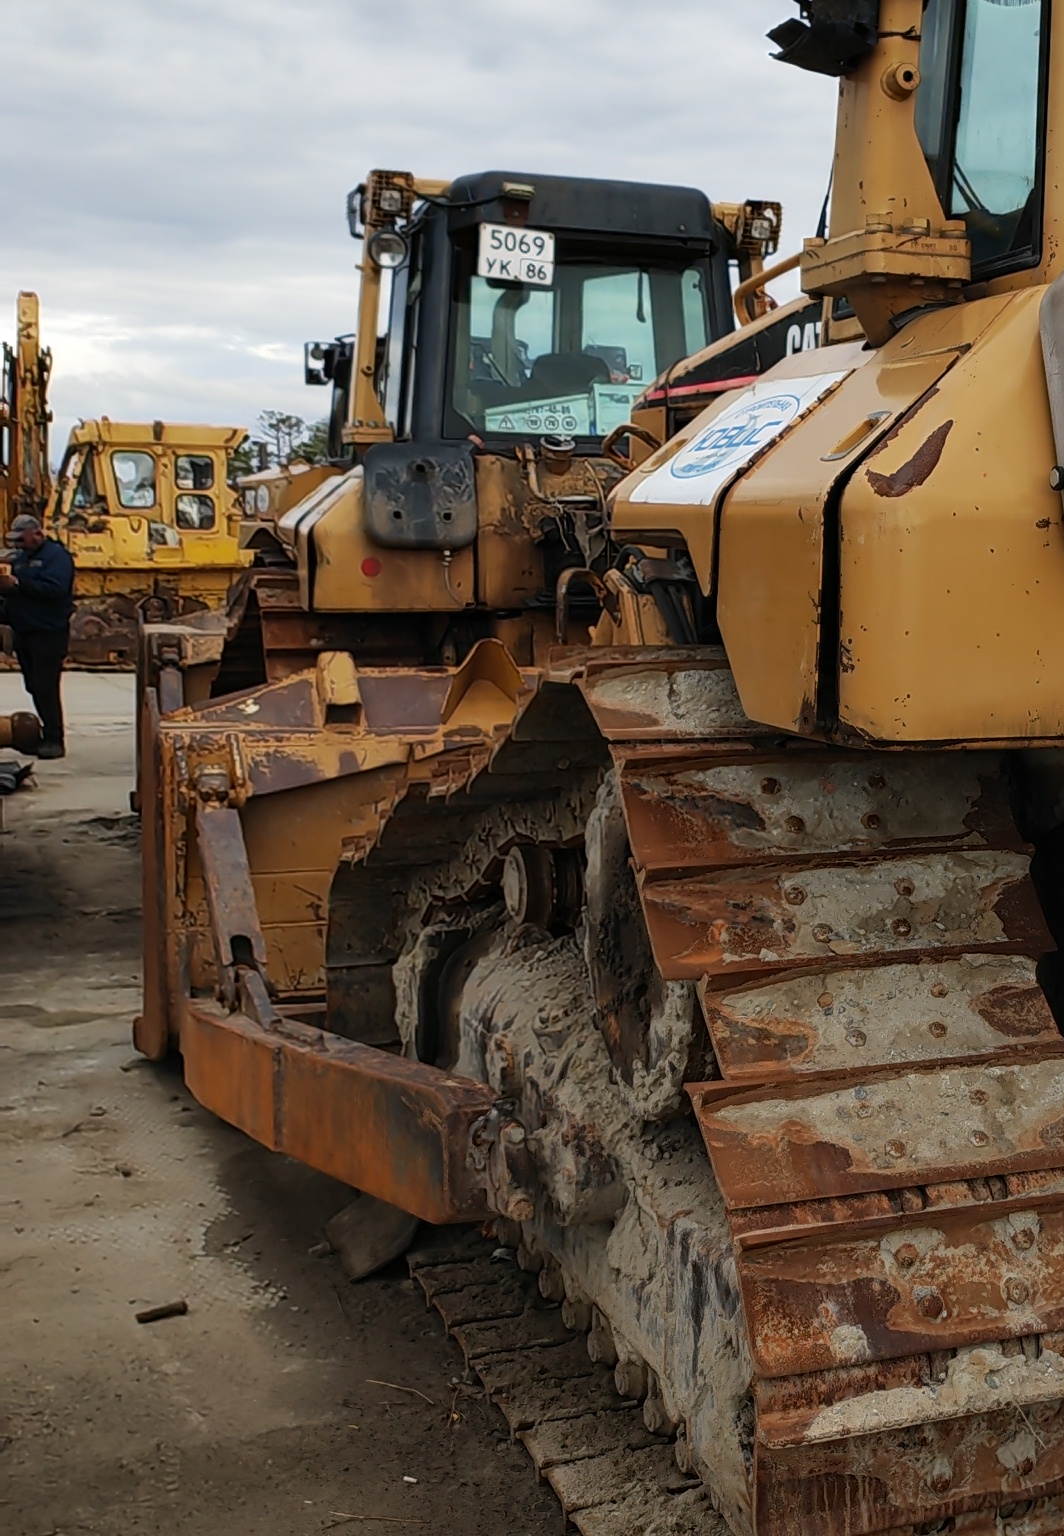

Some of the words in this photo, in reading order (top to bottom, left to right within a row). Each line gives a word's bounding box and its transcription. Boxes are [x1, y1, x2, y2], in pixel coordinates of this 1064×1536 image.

[490, 228, 546, 257] 5069
[486, 257, 512, 277] УК
[526, 263, 547, 281] 86
